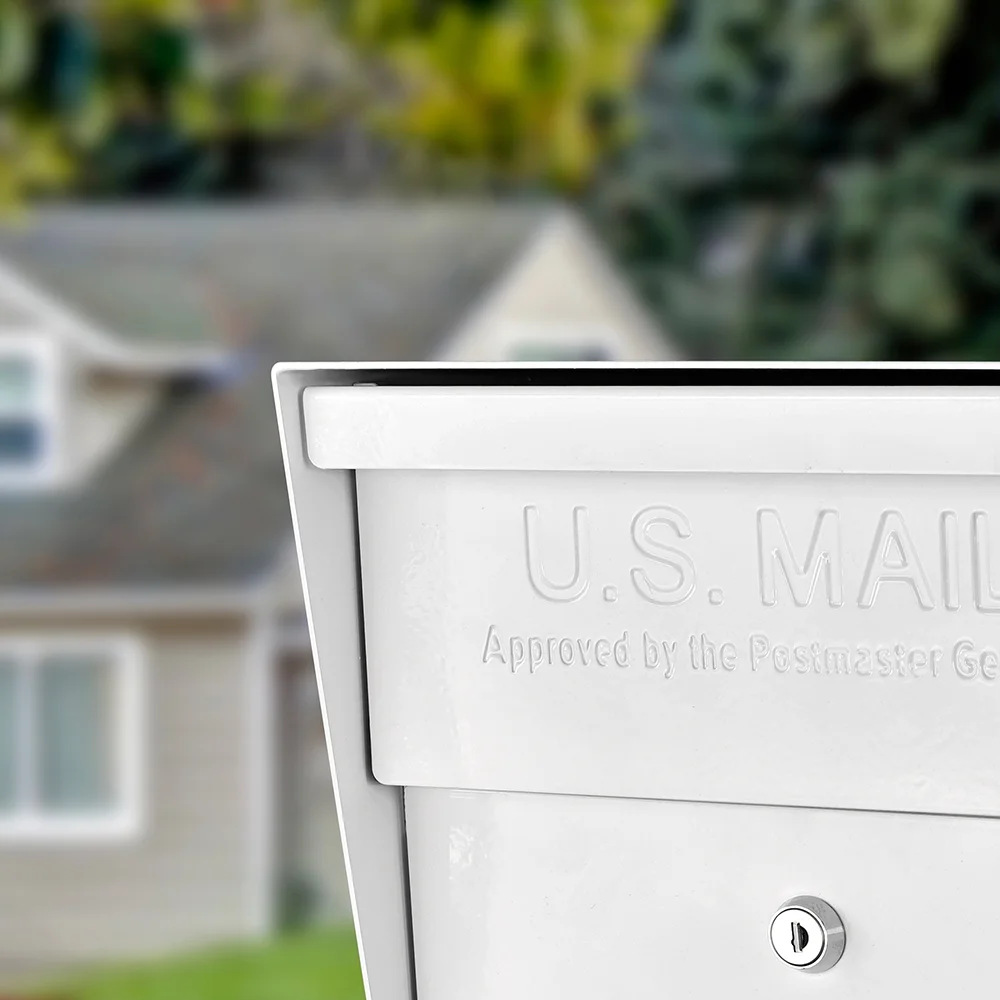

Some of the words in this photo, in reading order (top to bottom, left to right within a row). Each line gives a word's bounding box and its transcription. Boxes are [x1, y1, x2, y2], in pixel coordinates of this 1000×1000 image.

[523, 504, 725, 606] U.S.
[482, 624, 630, 674] Approved
[642, 630, 678, 680] by
[688, 632, 738, 672] the
[749, 634, 943, 678] Postmaster
